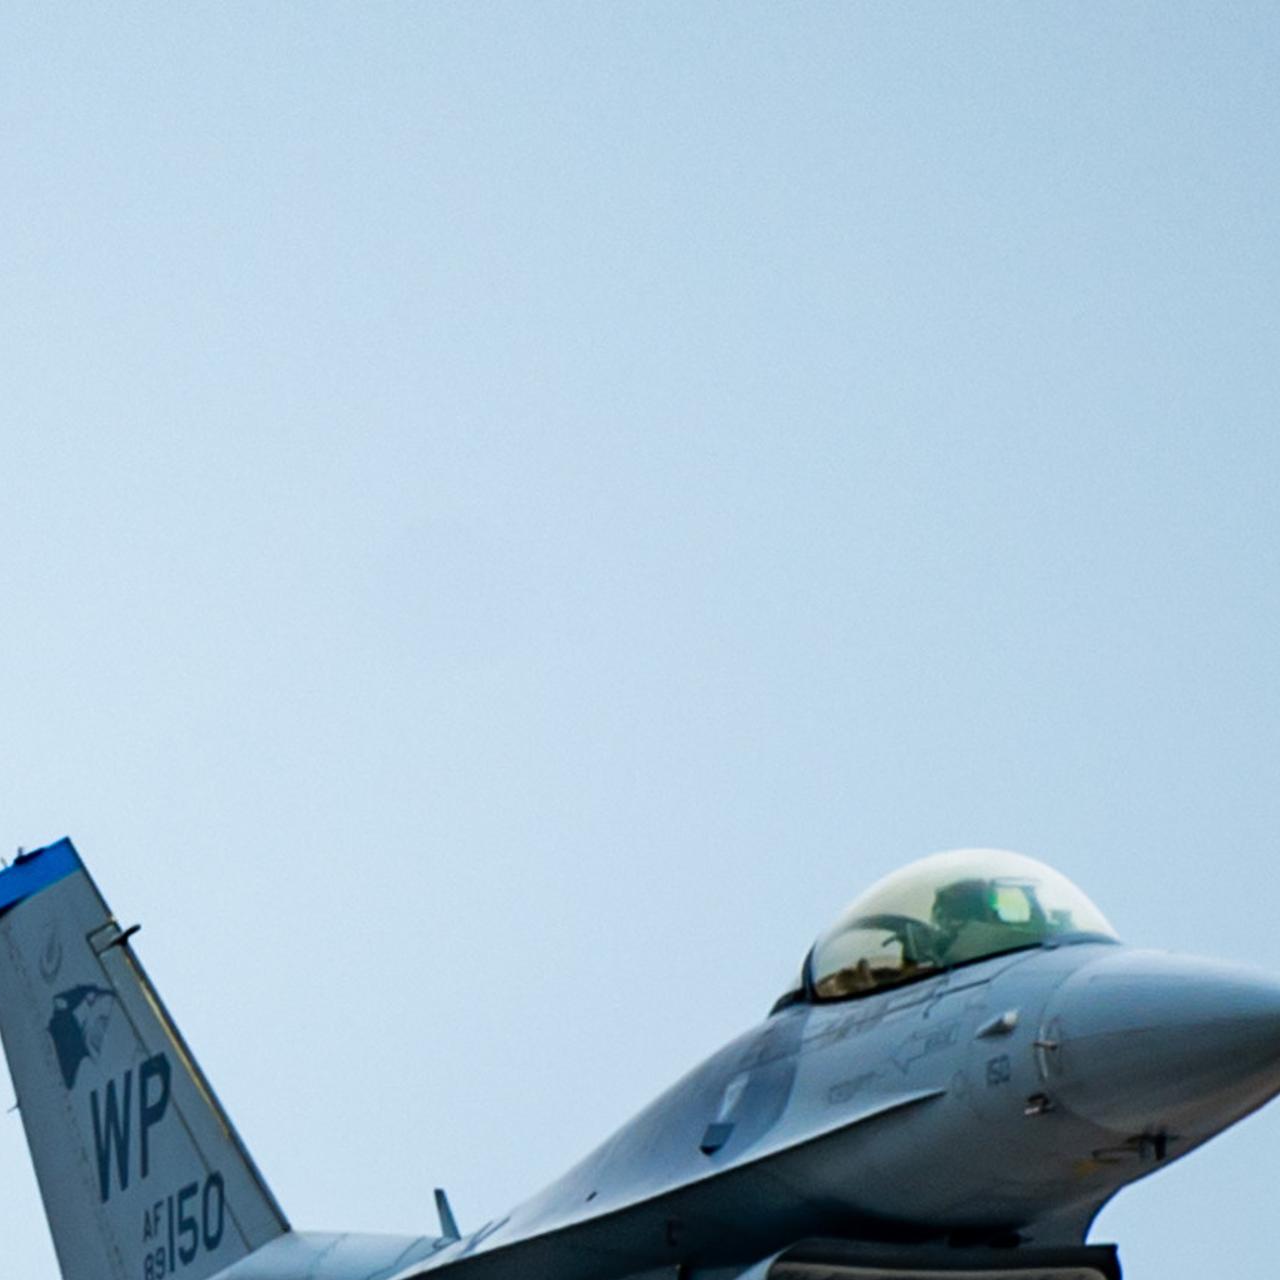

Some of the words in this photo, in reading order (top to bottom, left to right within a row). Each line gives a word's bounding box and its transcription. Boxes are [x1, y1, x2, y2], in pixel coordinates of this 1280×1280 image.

[90, 1053, 171, 1203] WP
[143, 1200, 163, 1242] AF
[168, 1171, 224, 1272] 150
